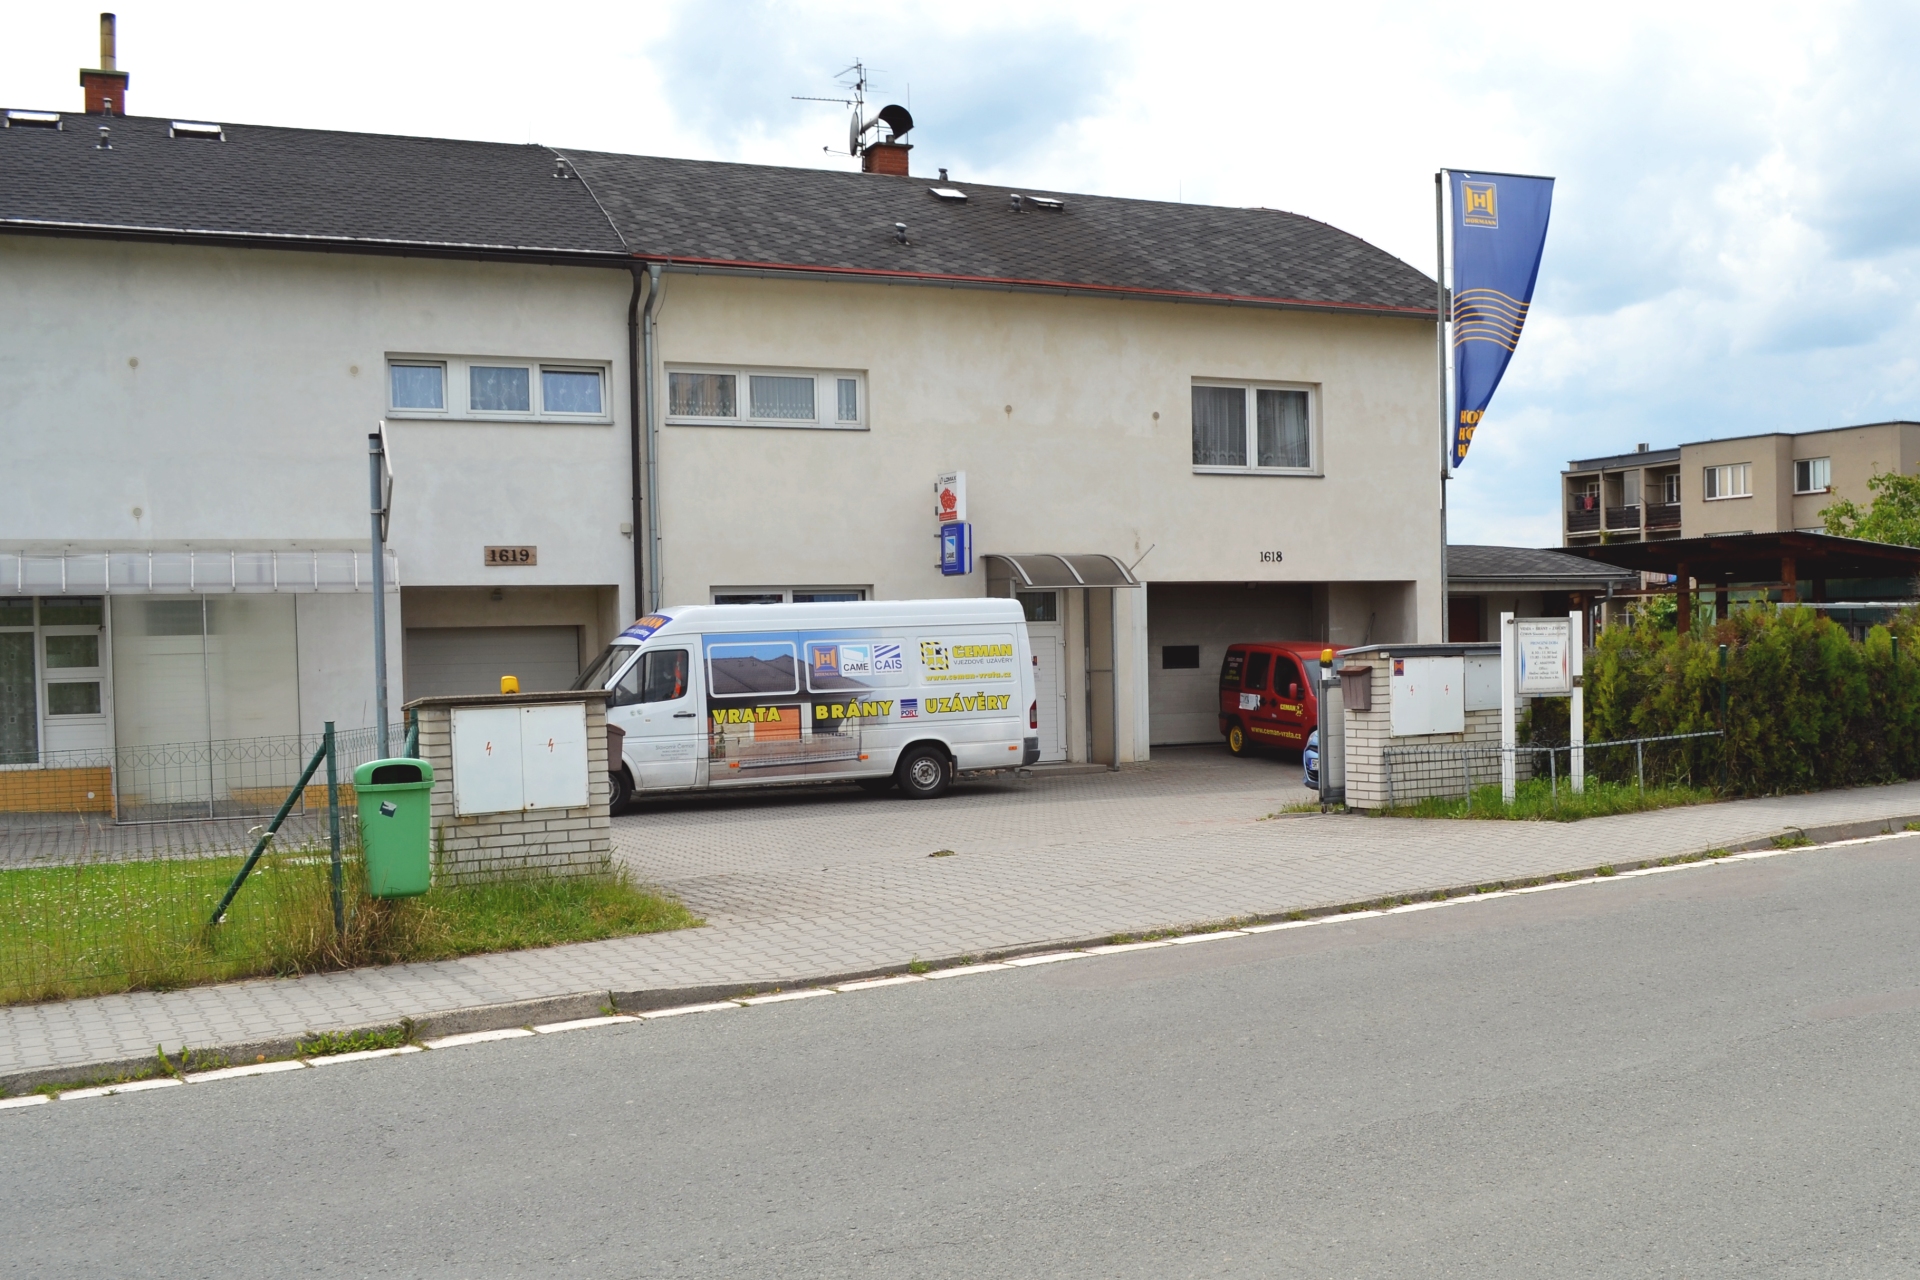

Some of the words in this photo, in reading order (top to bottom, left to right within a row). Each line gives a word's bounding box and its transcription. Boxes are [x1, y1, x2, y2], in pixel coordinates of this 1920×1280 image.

[490, 549, 530, 562] 1619
[1260, 551, 1283, 563] 1618
[952, 643, 1013, 659] ČEMAN
[874, 659, 902, 671] CAIS
[953, 657, 984, 665] VJEZDOVÉ
[986, 656, 1013, 664] UZÁVĚRY
[843, 663, 869, 672] CAME
[925, 691, 1011, 714] UZÁVĚRY
[815, 698, 894, 720] BRÁNY
[900, 709, 918, 717] PORT
[712, 707, 781, 724] VRATA
